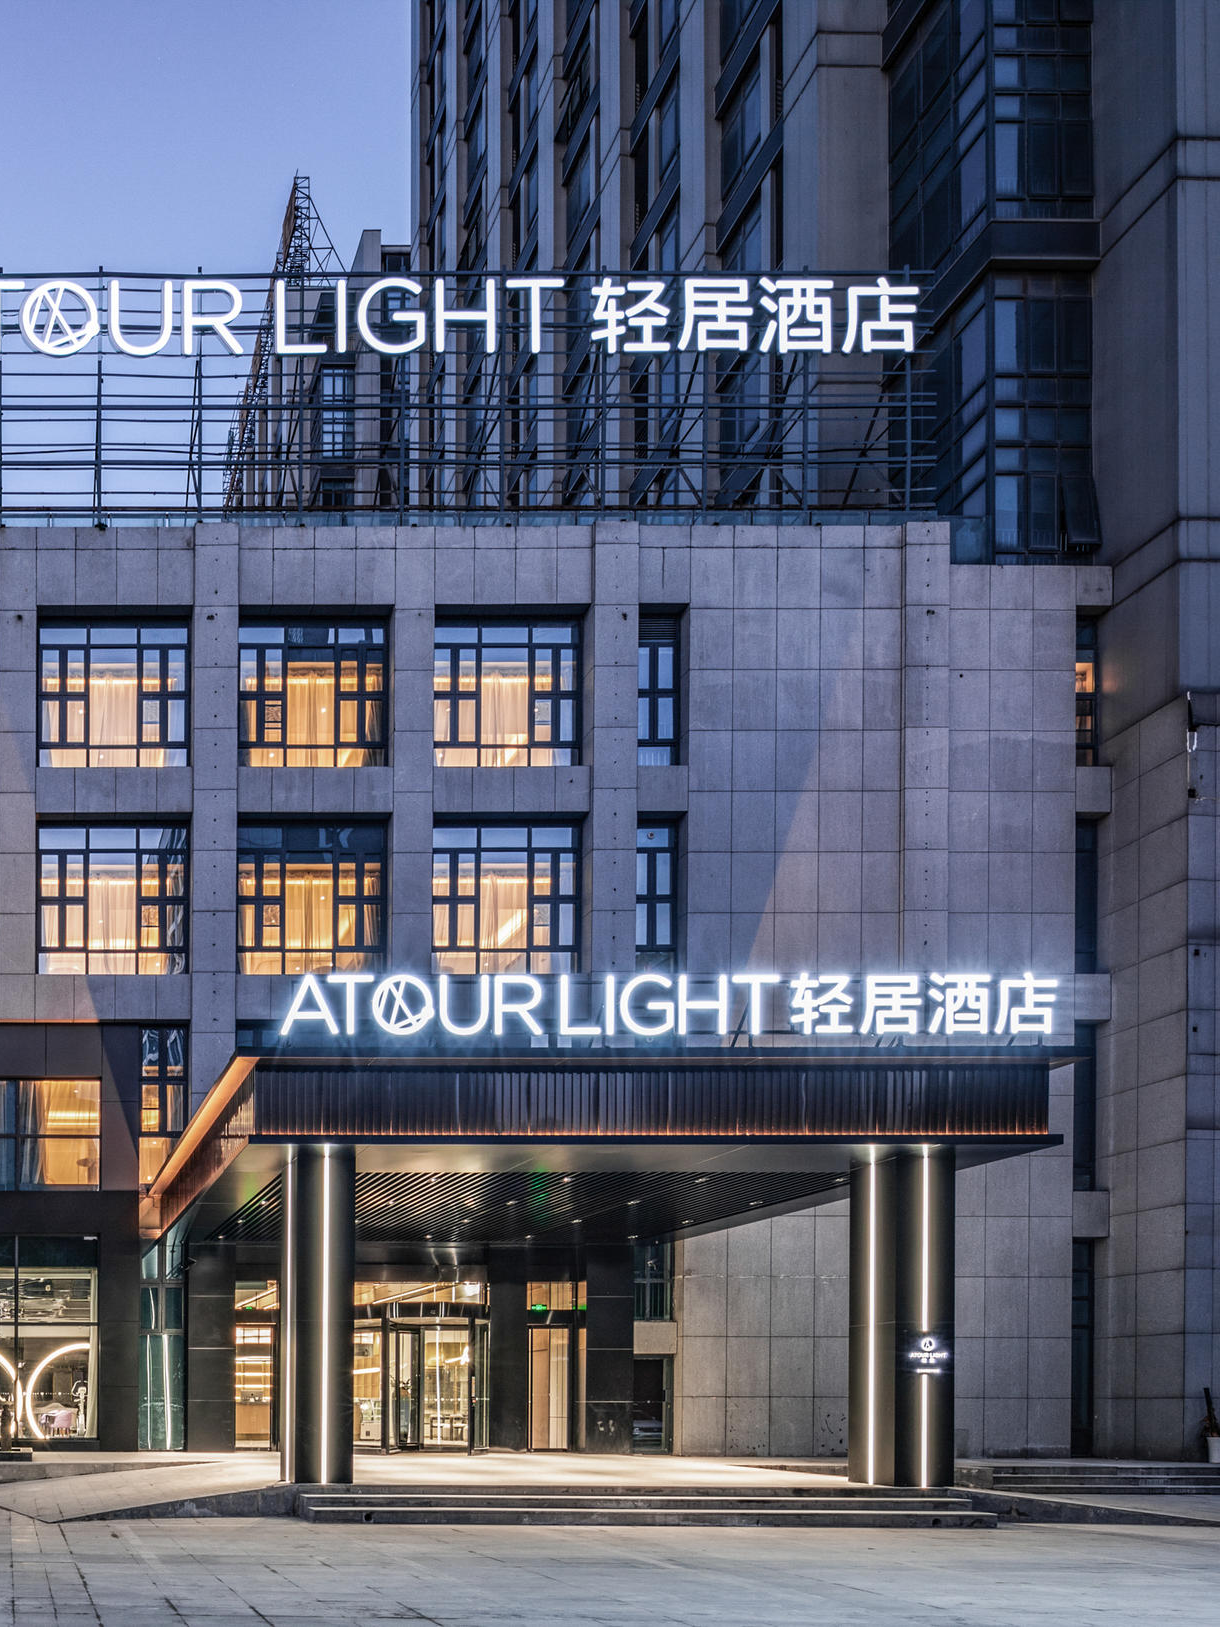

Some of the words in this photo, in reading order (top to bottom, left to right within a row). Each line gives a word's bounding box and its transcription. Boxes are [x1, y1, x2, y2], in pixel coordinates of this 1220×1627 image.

[276, 278, 565, 356] LIGHT
[591, 277, 919, 353] 轻居酒店
[280, 973, 543, 1037] ATOUR
[560, 973, 780, 1036] LIGHT
[790, 971, 1059, 1036] 轻居酒店
